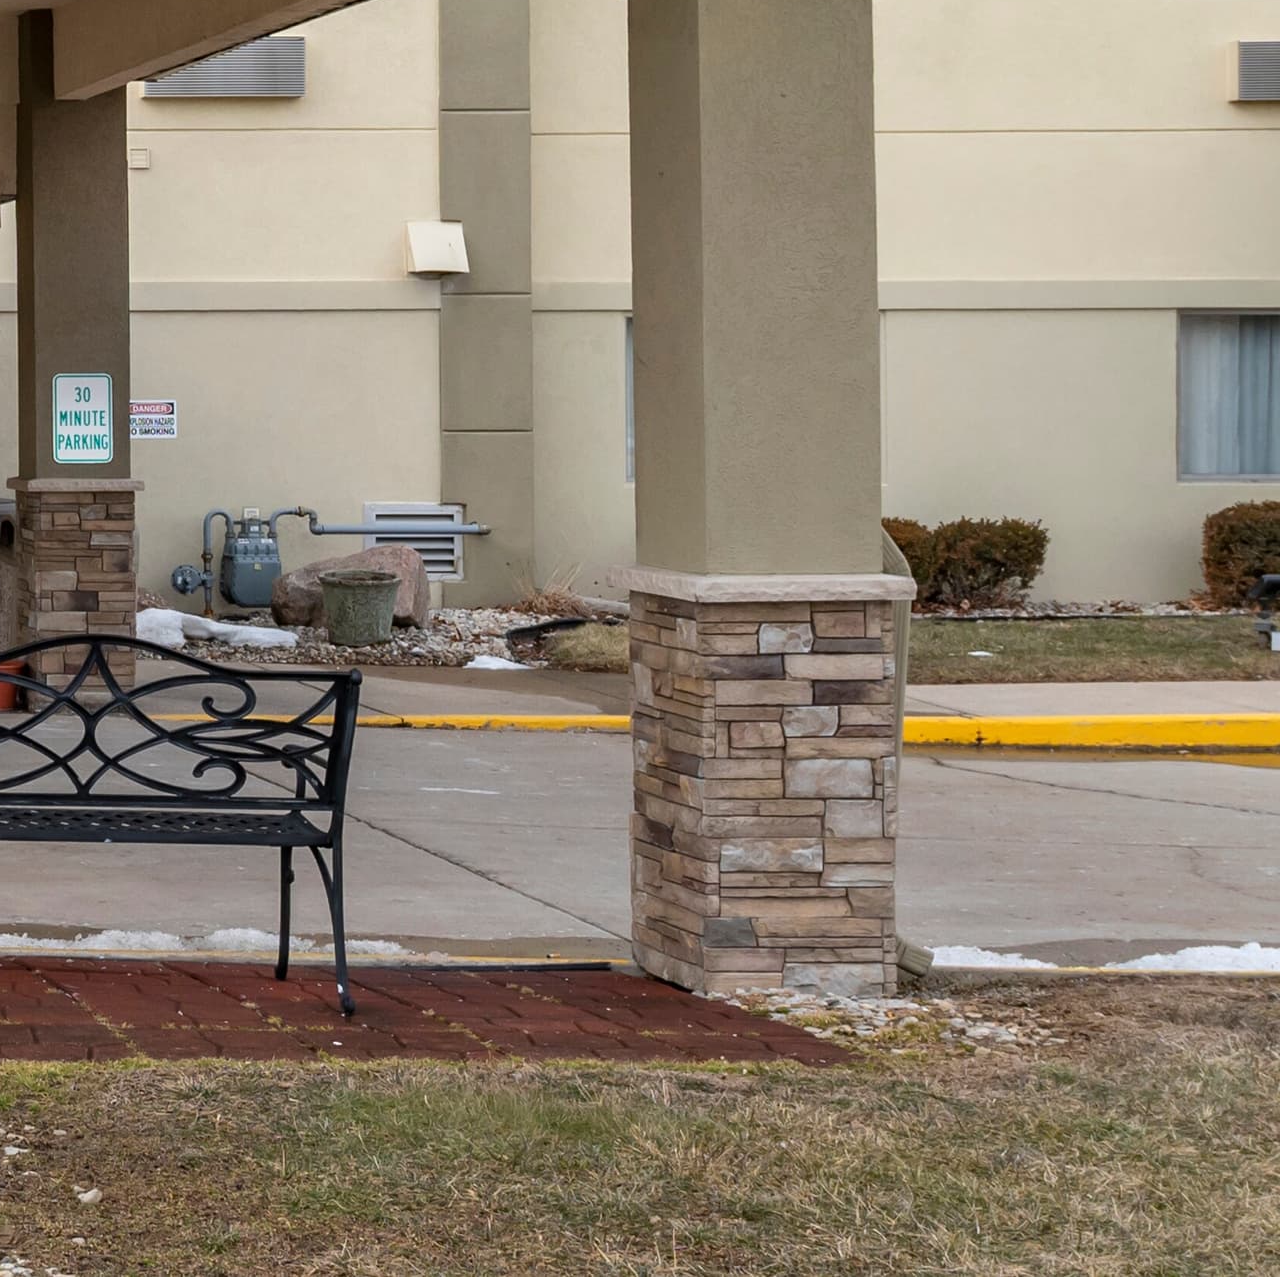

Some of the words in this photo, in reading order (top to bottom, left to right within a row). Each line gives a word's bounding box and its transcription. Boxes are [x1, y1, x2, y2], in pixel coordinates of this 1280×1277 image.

[74, 386, 91, 403] 30
[132, 405, 168, 413] DANGER
[59, 410, 107, 426] MINUTE
[58, 434, 109, 450] PARKING
